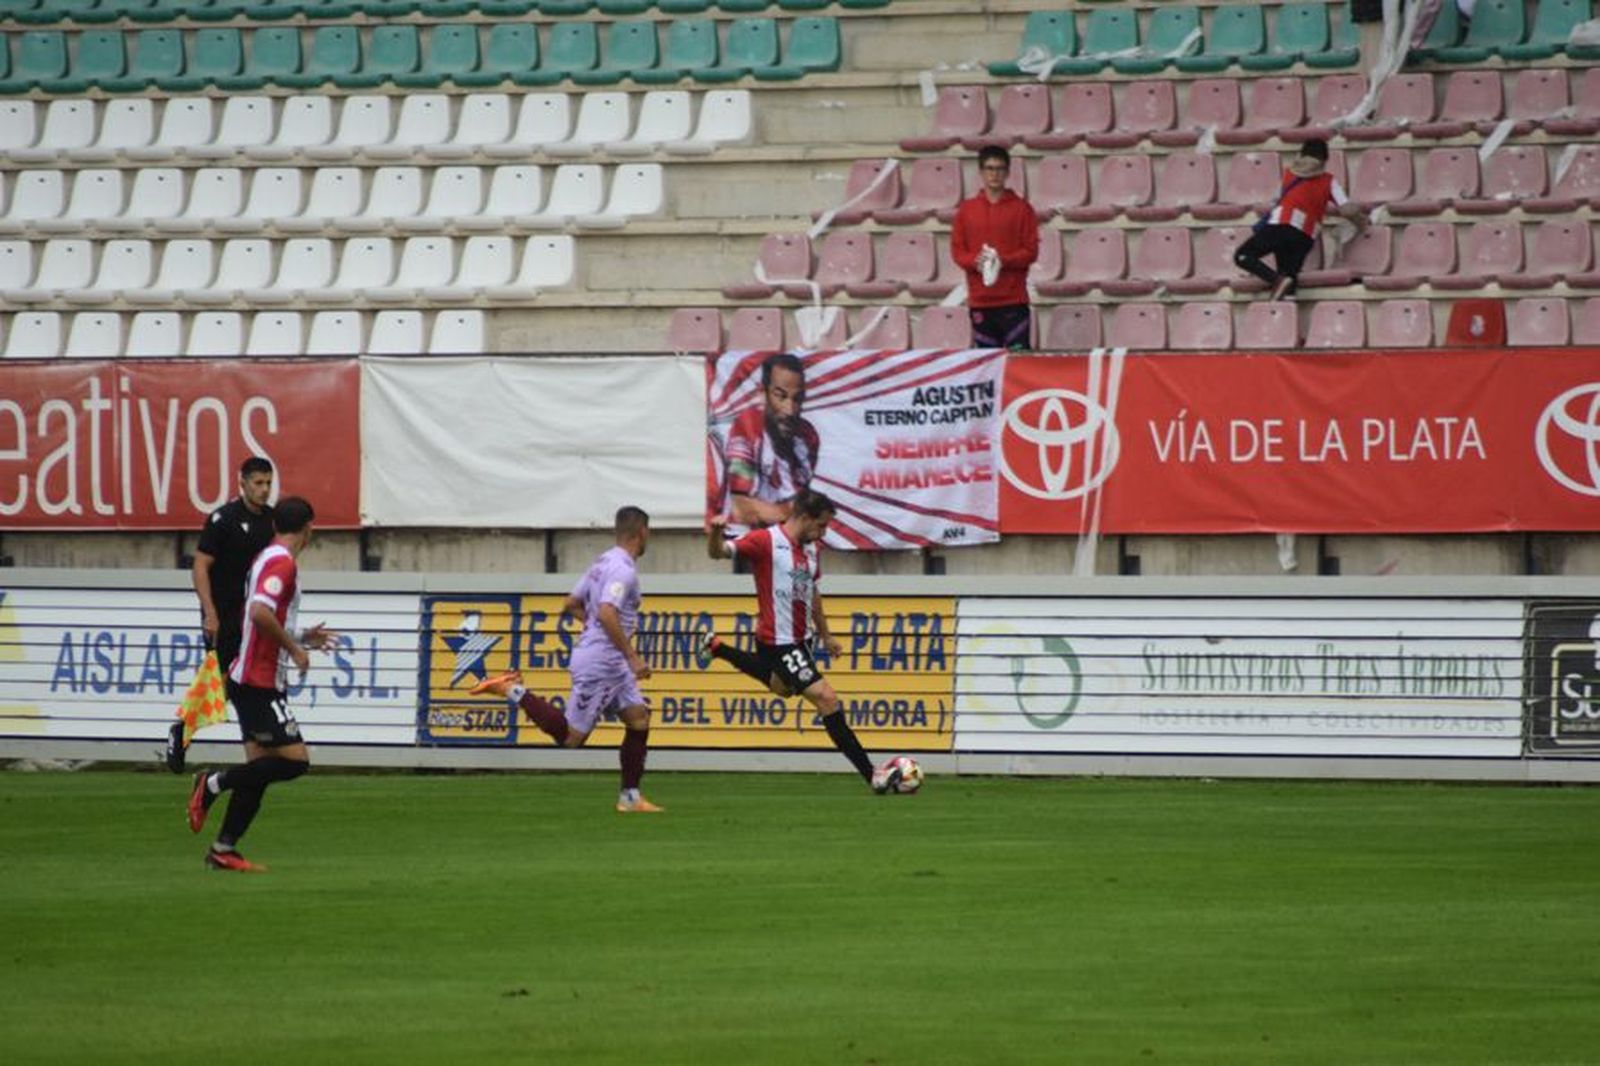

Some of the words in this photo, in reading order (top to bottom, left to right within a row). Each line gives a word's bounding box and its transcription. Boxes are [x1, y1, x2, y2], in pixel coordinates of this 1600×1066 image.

[865, 409, 928, 425] ETERNO
[1149, 409, 1216, 463] VÍA
[1229, 420, 1283, 462] DE
[1299, 419, 1348, 462] LA
[1362, 417, 1486, 461] PLATA
[332, 635, 398, 698] S.L.
[782, 649, 808, 673] 22
[850, 612, 946, 671] PLATA
[1316, 642, 1382, 694] TRES
[661, 697, 710, 724] DEL
[721, 698, 787, 726] VINO
